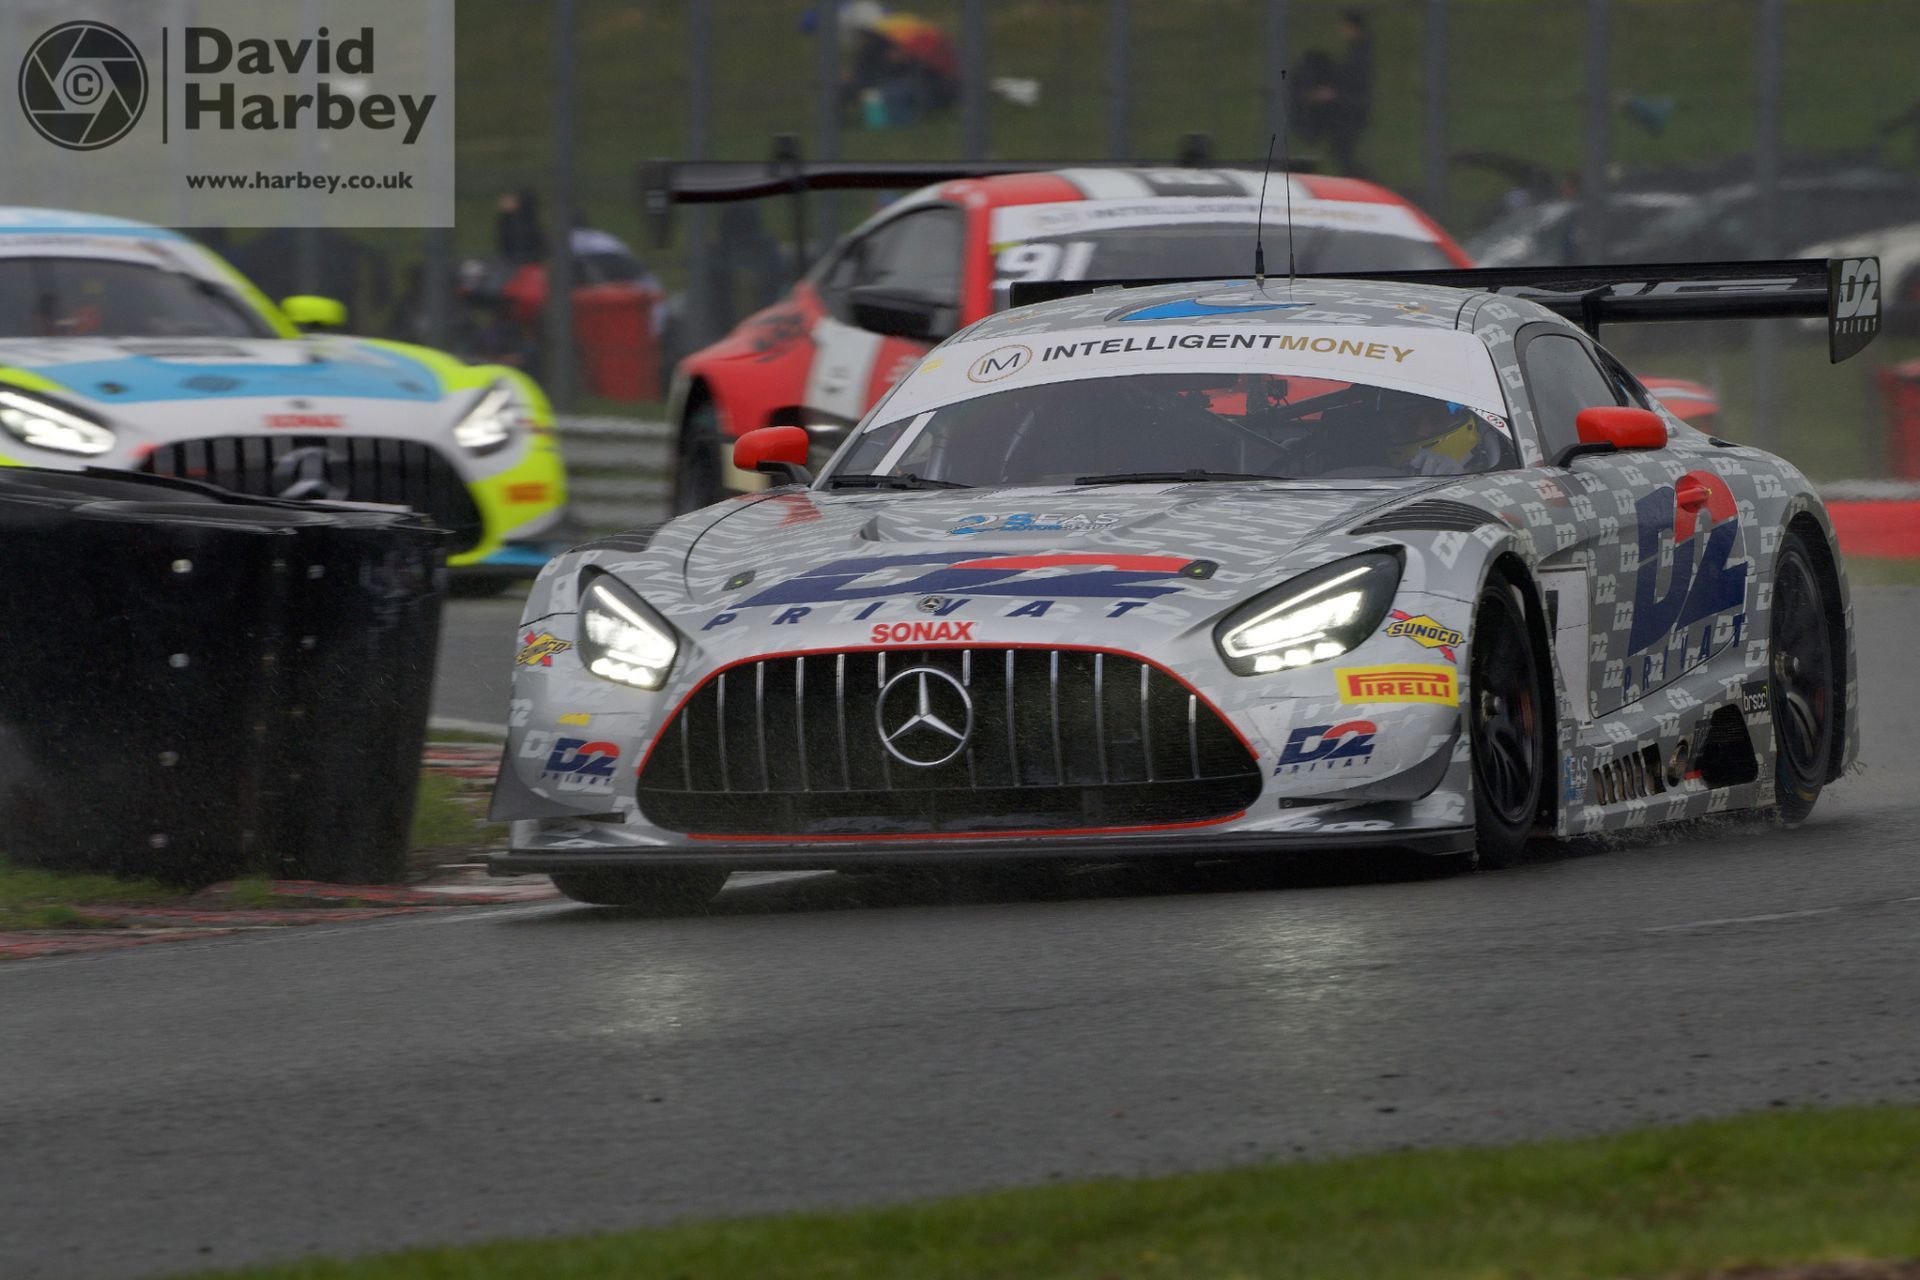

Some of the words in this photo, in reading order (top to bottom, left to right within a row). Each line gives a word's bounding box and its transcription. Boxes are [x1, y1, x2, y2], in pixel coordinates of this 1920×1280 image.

[990, 243, 1098, 289] 91
[1837, 259, 1879, 318] D2
[1628, 470, 1748, 657] D2
[701, 600, 1149, 631] PRIVAT
[871, 621, 975, 644] SONAX
[1393, 623, 1459, 645] SUNOCO
[1347, 672, 1450, 698] PIRELLI
[546, 737, 621, 777] D2
[1276, 719, 1377, 766] D2
[1273, 756, 1371, 776] PRIVAT
